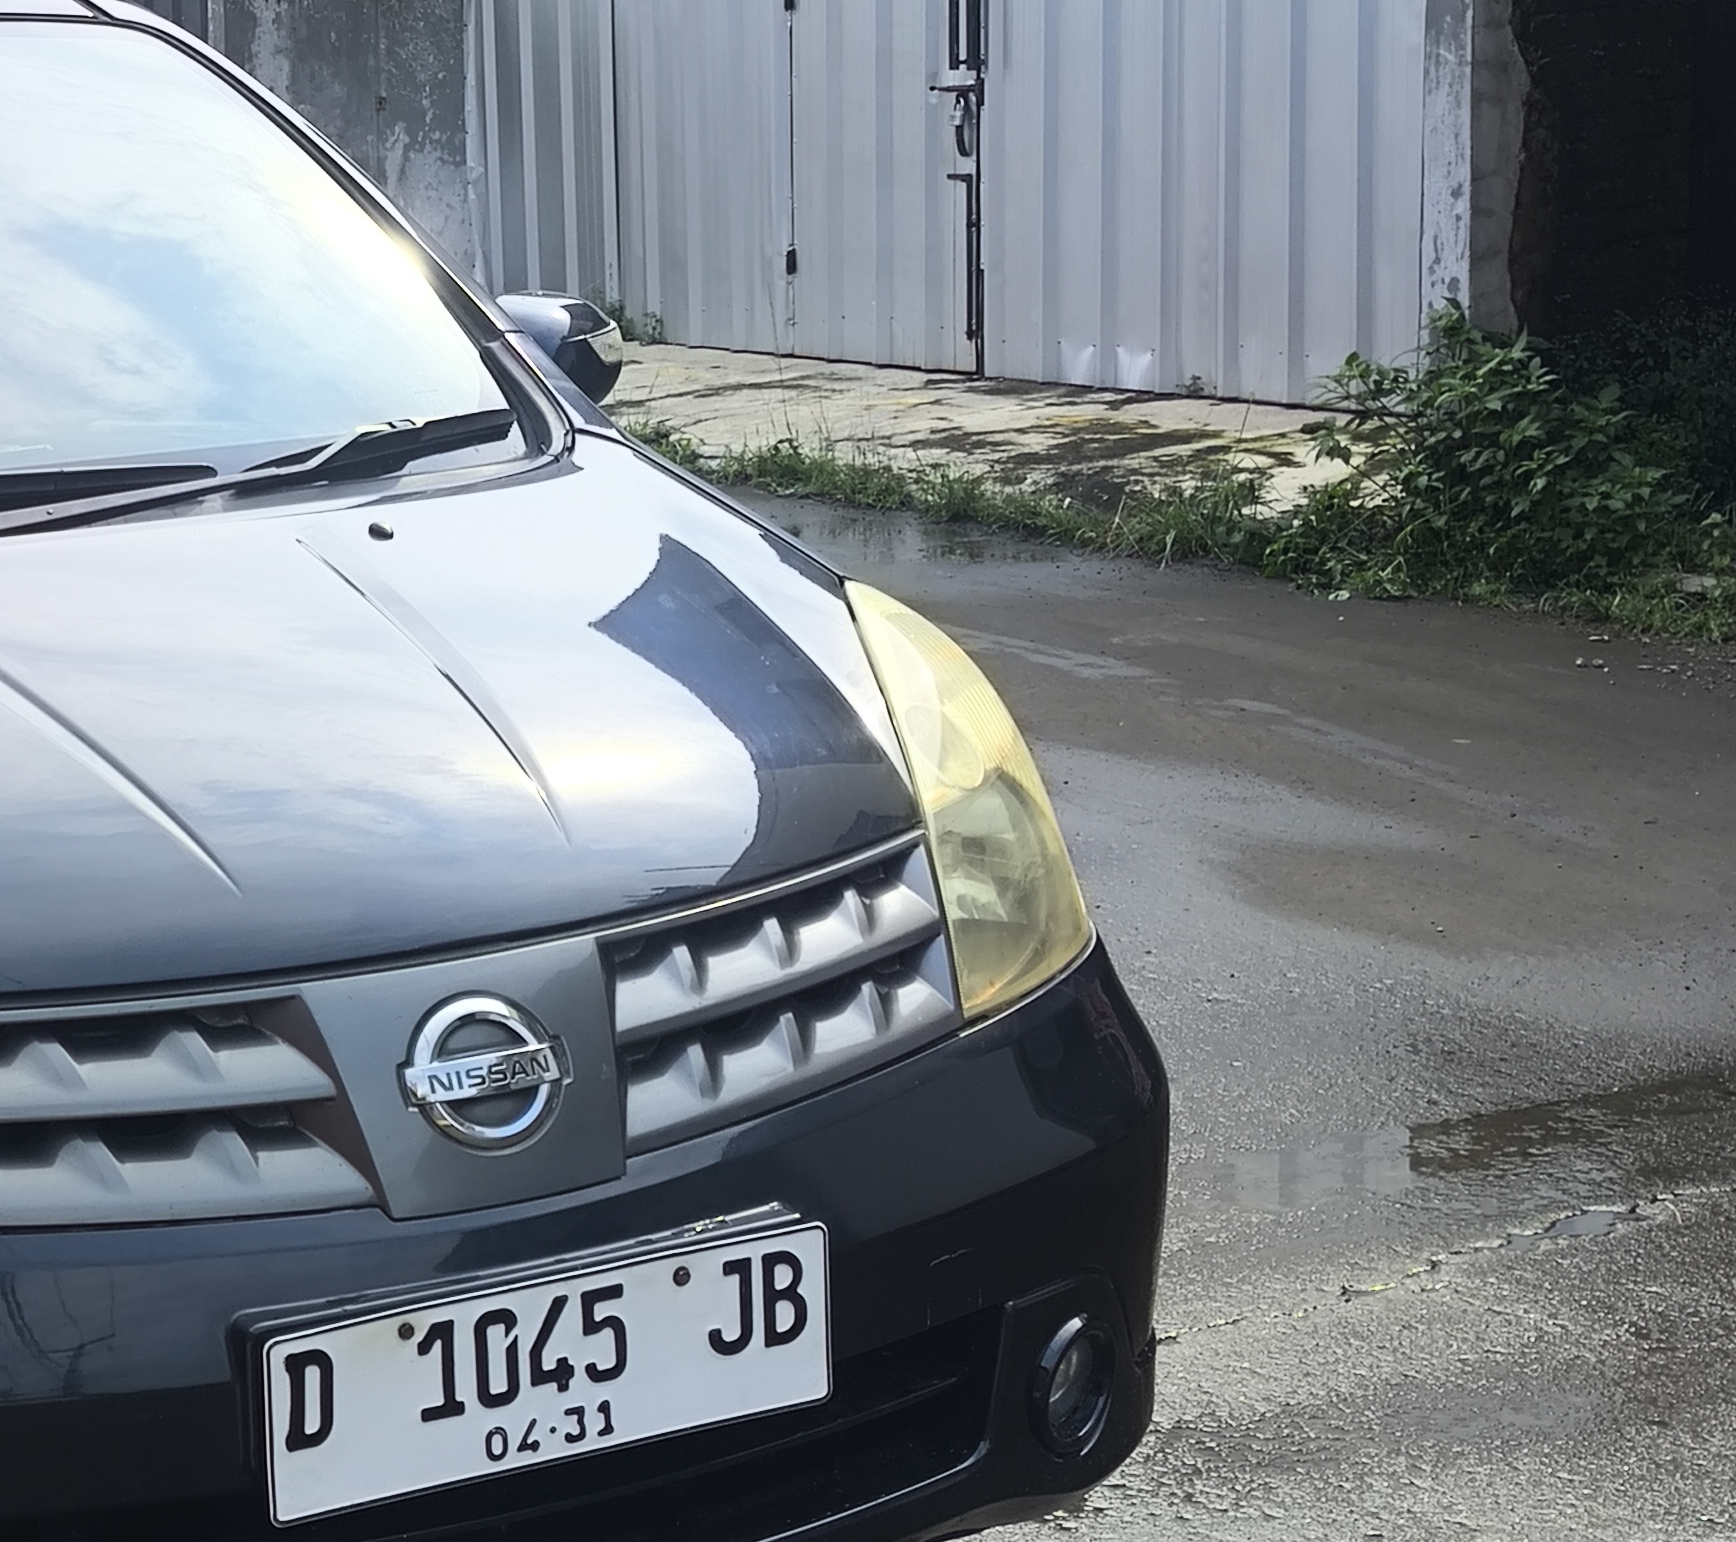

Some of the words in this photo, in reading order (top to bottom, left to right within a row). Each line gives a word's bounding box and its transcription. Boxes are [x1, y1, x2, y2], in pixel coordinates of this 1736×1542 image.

[427, 1053, 552, 1095] NISSAN
[284, 1348, 334, 1453] D
[416, 1283, 628, 1423] 1045
[707, 1250, 808, 1357] JB
